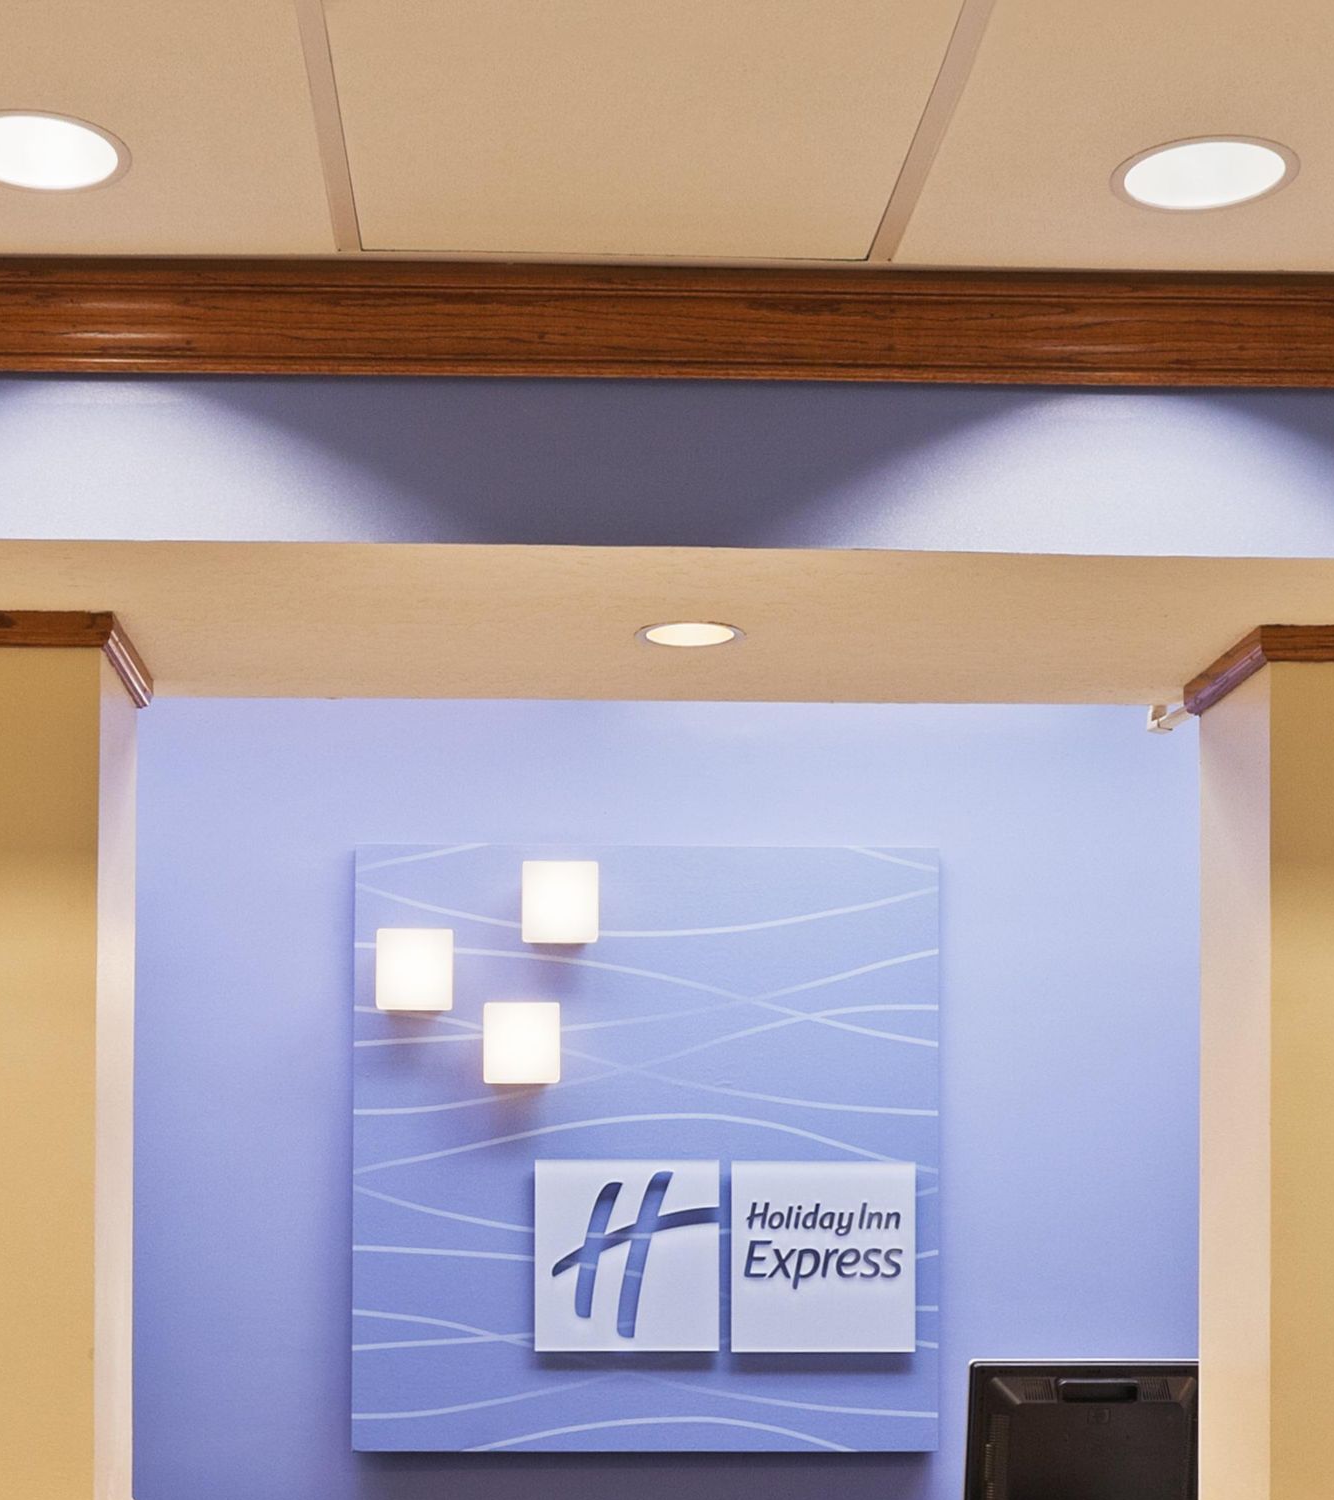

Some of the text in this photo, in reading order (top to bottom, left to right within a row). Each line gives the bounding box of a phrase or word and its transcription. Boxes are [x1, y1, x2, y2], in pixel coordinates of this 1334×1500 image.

[746, 1201, 901, 1237] Holiday Inn
[743, 1239, 903, 1290] Express
